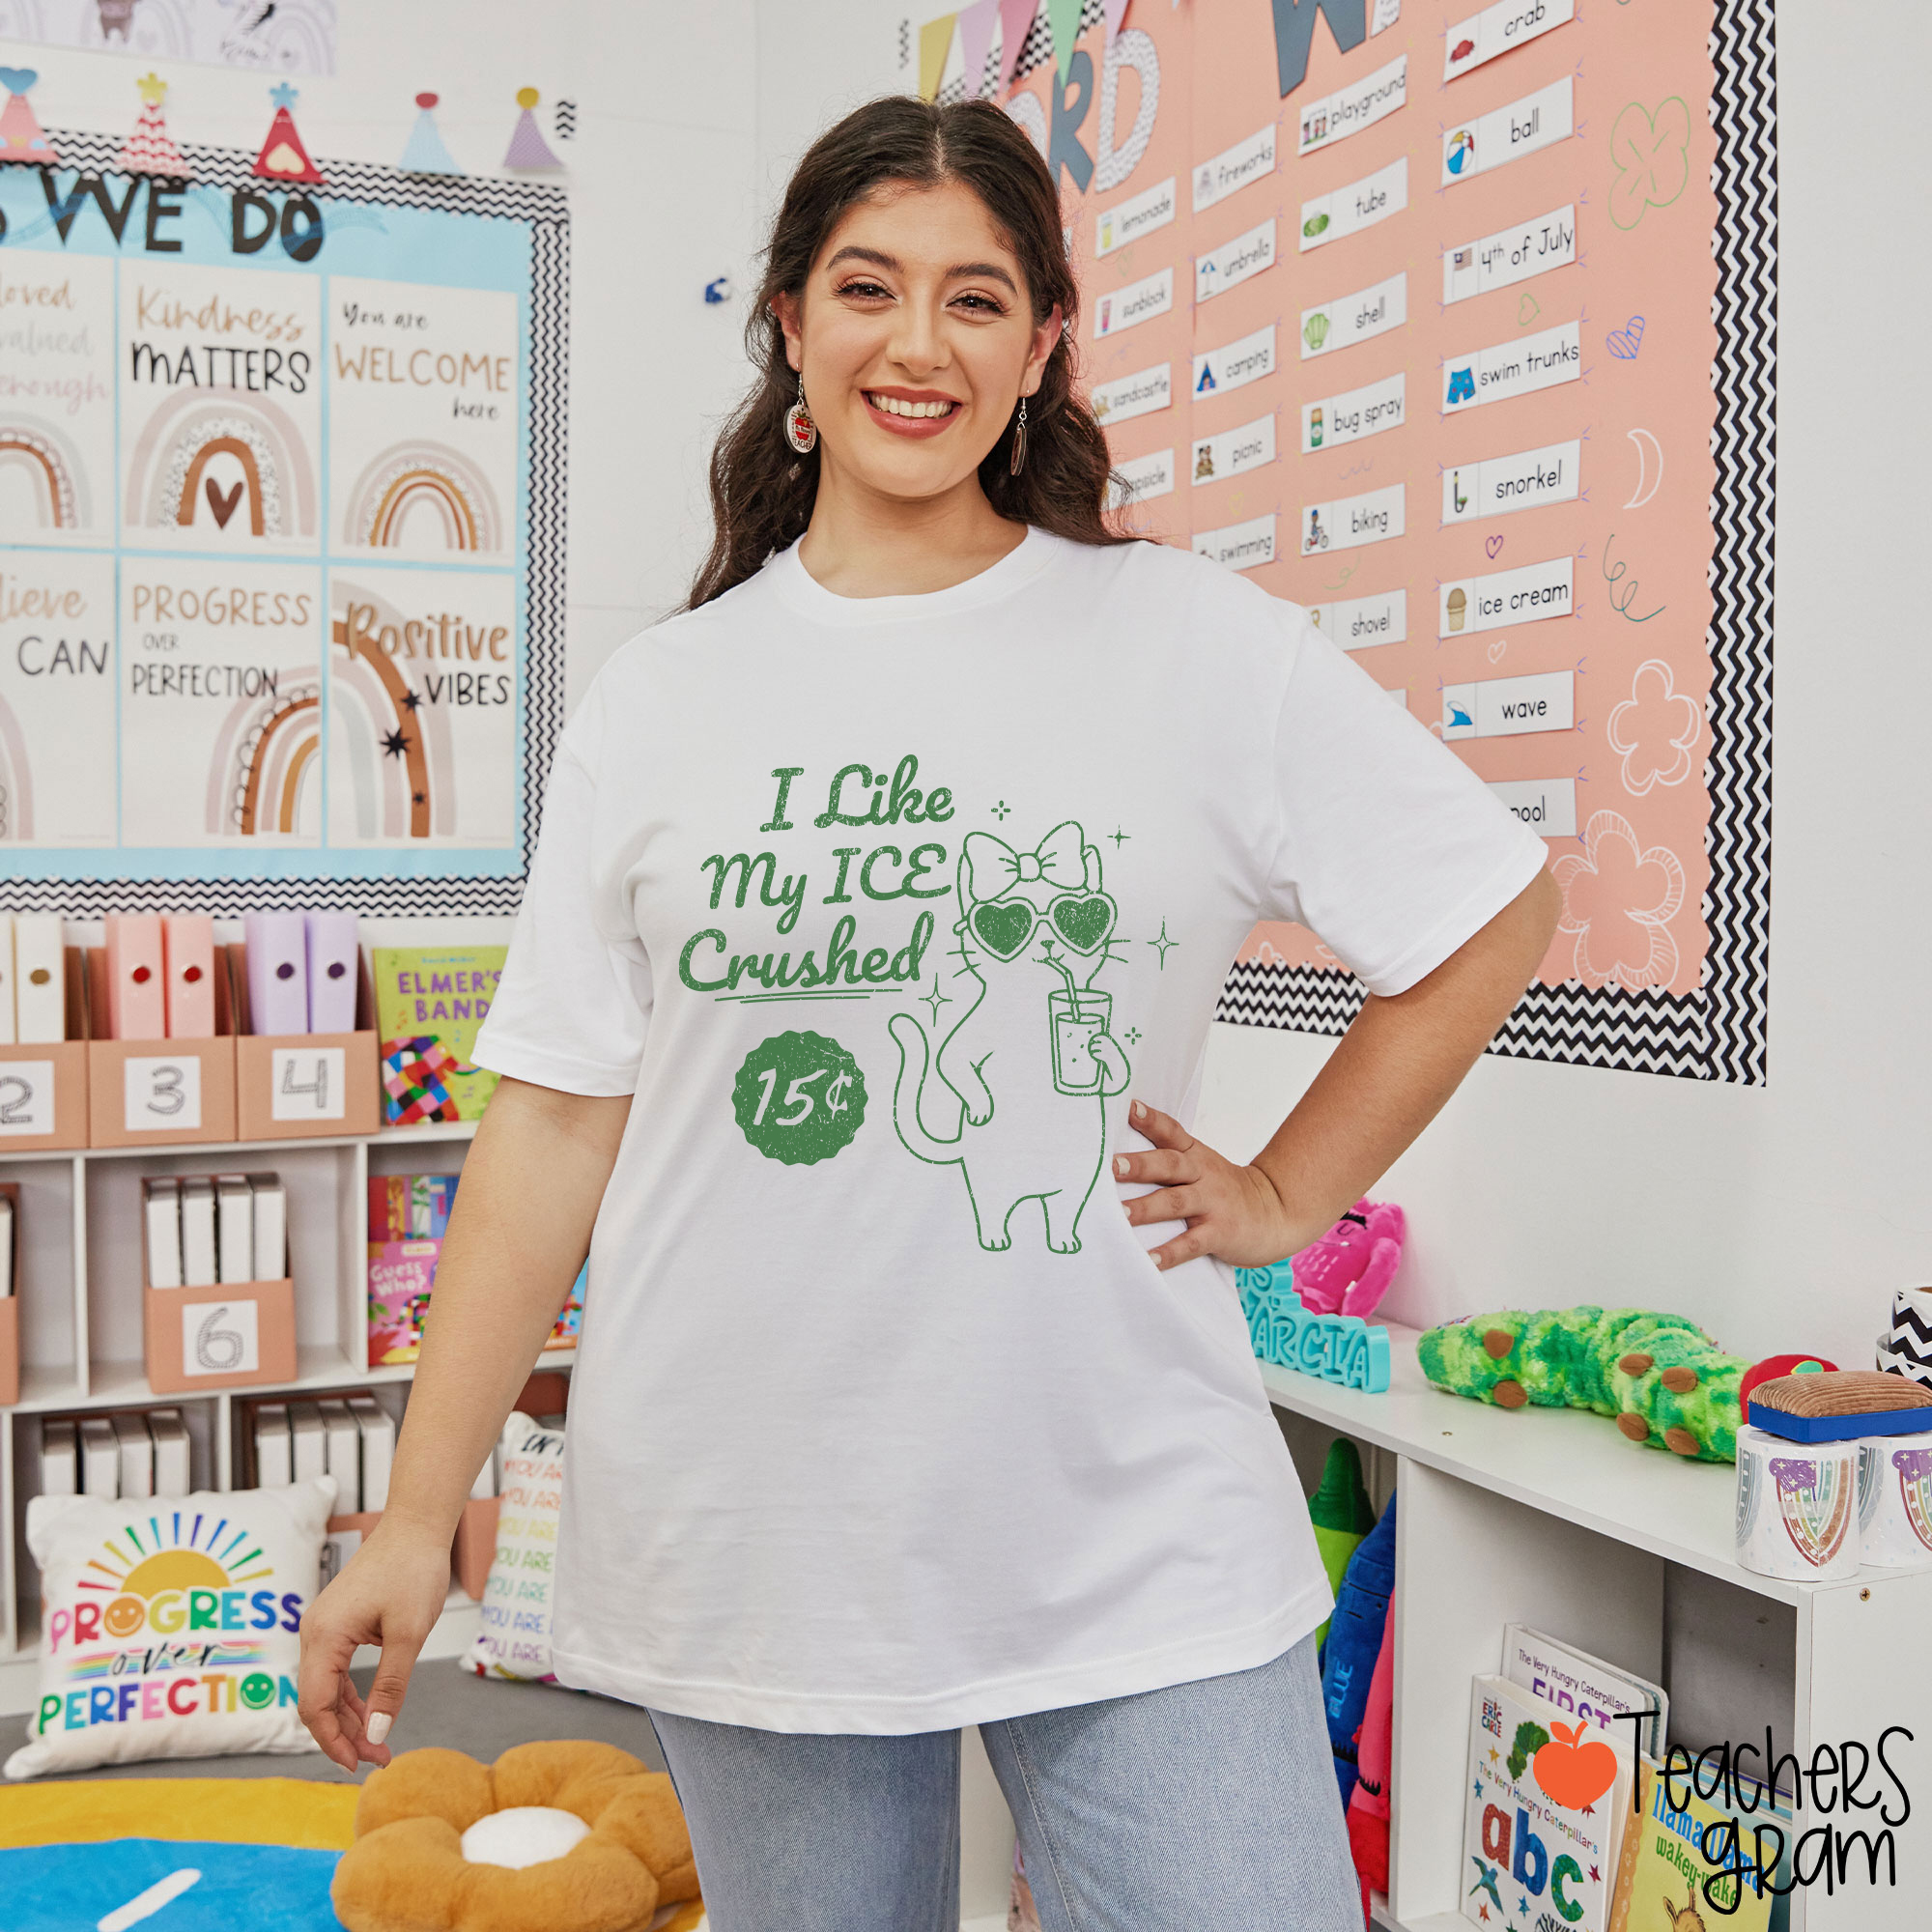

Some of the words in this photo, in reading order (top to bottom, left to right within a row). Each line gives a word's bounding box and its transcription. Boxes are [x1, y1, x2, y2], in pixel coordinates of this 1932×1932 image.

[1504, 0, 1547, 37] crab
[1330, 63, 1406, 132] playground
[1510, 106, 1541, 144] ball
[1217, 142, 1274, 187] fireworks
[38, 167, 187, 253] WE
[232, 189, 325, 263] DO
[1121, 190, 1172, 233] lemonade
[1356, 188, 1387, 217] tube
[1224, 236, 1270, 277] umbrella
[1510, 235, 1531, 267] of
[1538, 222, 1574, 257] July
[136, 285, 305, 342] Kindness
[344, 302, 386, 327] You
[393, 312, 429, 330] are
[1122, 283, 1167, 319] sunblock
[1356, 295, 1386, 329] shell
[131, 341, 311, 394] MATTERS
[335, 342, 512, 392] WELCOME
[1226, 345, 1269, 379] camping
[1480, 360, 1520, 386] swim
[1526, 340, 1579, 374] trunks
[452, 396, 499, 420] here
[1113, 373, 1169, 408] sandcastle
[1334, 410, 1360, 433] bug
[1365, 396, 1404, 424] spray
[1232, 439, 1264, 468] picnic
[1495, 458, 1562, 499] snorkel
[1351, 510, 1389, 534] biking
[1219, 534, 1273, 563] swimming
[132, 584, 312, 626] PROGRESS
[1478, 595, 1503, 617] ice
[1510, 582, 1569, 611] cream
[346, 601, 510, 663] Positive
[1350, 606, 1391, 637] shovel
[17, 634, 109, 676] CAN
[143, 633, 180, 651] OVER
[132, 663, 279, 697] PERFECTION
[424, 671, 512, 707] VIBES
[1501, 699, 1548, 720] wave
[759, 766, 805, 833] I
[813, 753, 955, 829] Like
[699, 850, 808, 935] My
[821, 842, 952, 905] ICE
[678, 910, 935, 992] Crushed
[414, 998, 493, 1023] BAND
[147, 1065, 185, 1115] 3
[281, 1058, 327, 1109] 4
[369, 1261, 424, 1284] Guess
[197, 1306, 243, 1370] 6
[522, 1550, 554, 1573] ARE
[517, 1581, 549, 1605] ARE
[50, 1590, 302, 1655] PROGRESS
[514, 1608, 546, 1633] ARE
[111, 1640, 240, 1676] over
[510, 1640, 544, 1662] ARE
[1327, 1659, 1353, 1719] BLUE
[1519, 1648, 1532, 1666] The
[1533, 1655, 1549, 1677] Very
[1551, 1667, 1579, 1692] Hungry
[1581, 1680, 1631, 1715] Caterpillar's
[38, 1672, 299, 1736] PERFECTION
[1482, 1701, 1503, 1725] ERIC
[1481, 1715, 1502, 1739] CARLE
[1479, 1760, 1492, 1779] The
[1494, 1772, 1512, 1798] Very
[1513, 1786, 1543, 1819] Hungry
[1544, 1809, 1599, 1855] Caterpillar's
[1481, 1803, 1584, 1923] abc
